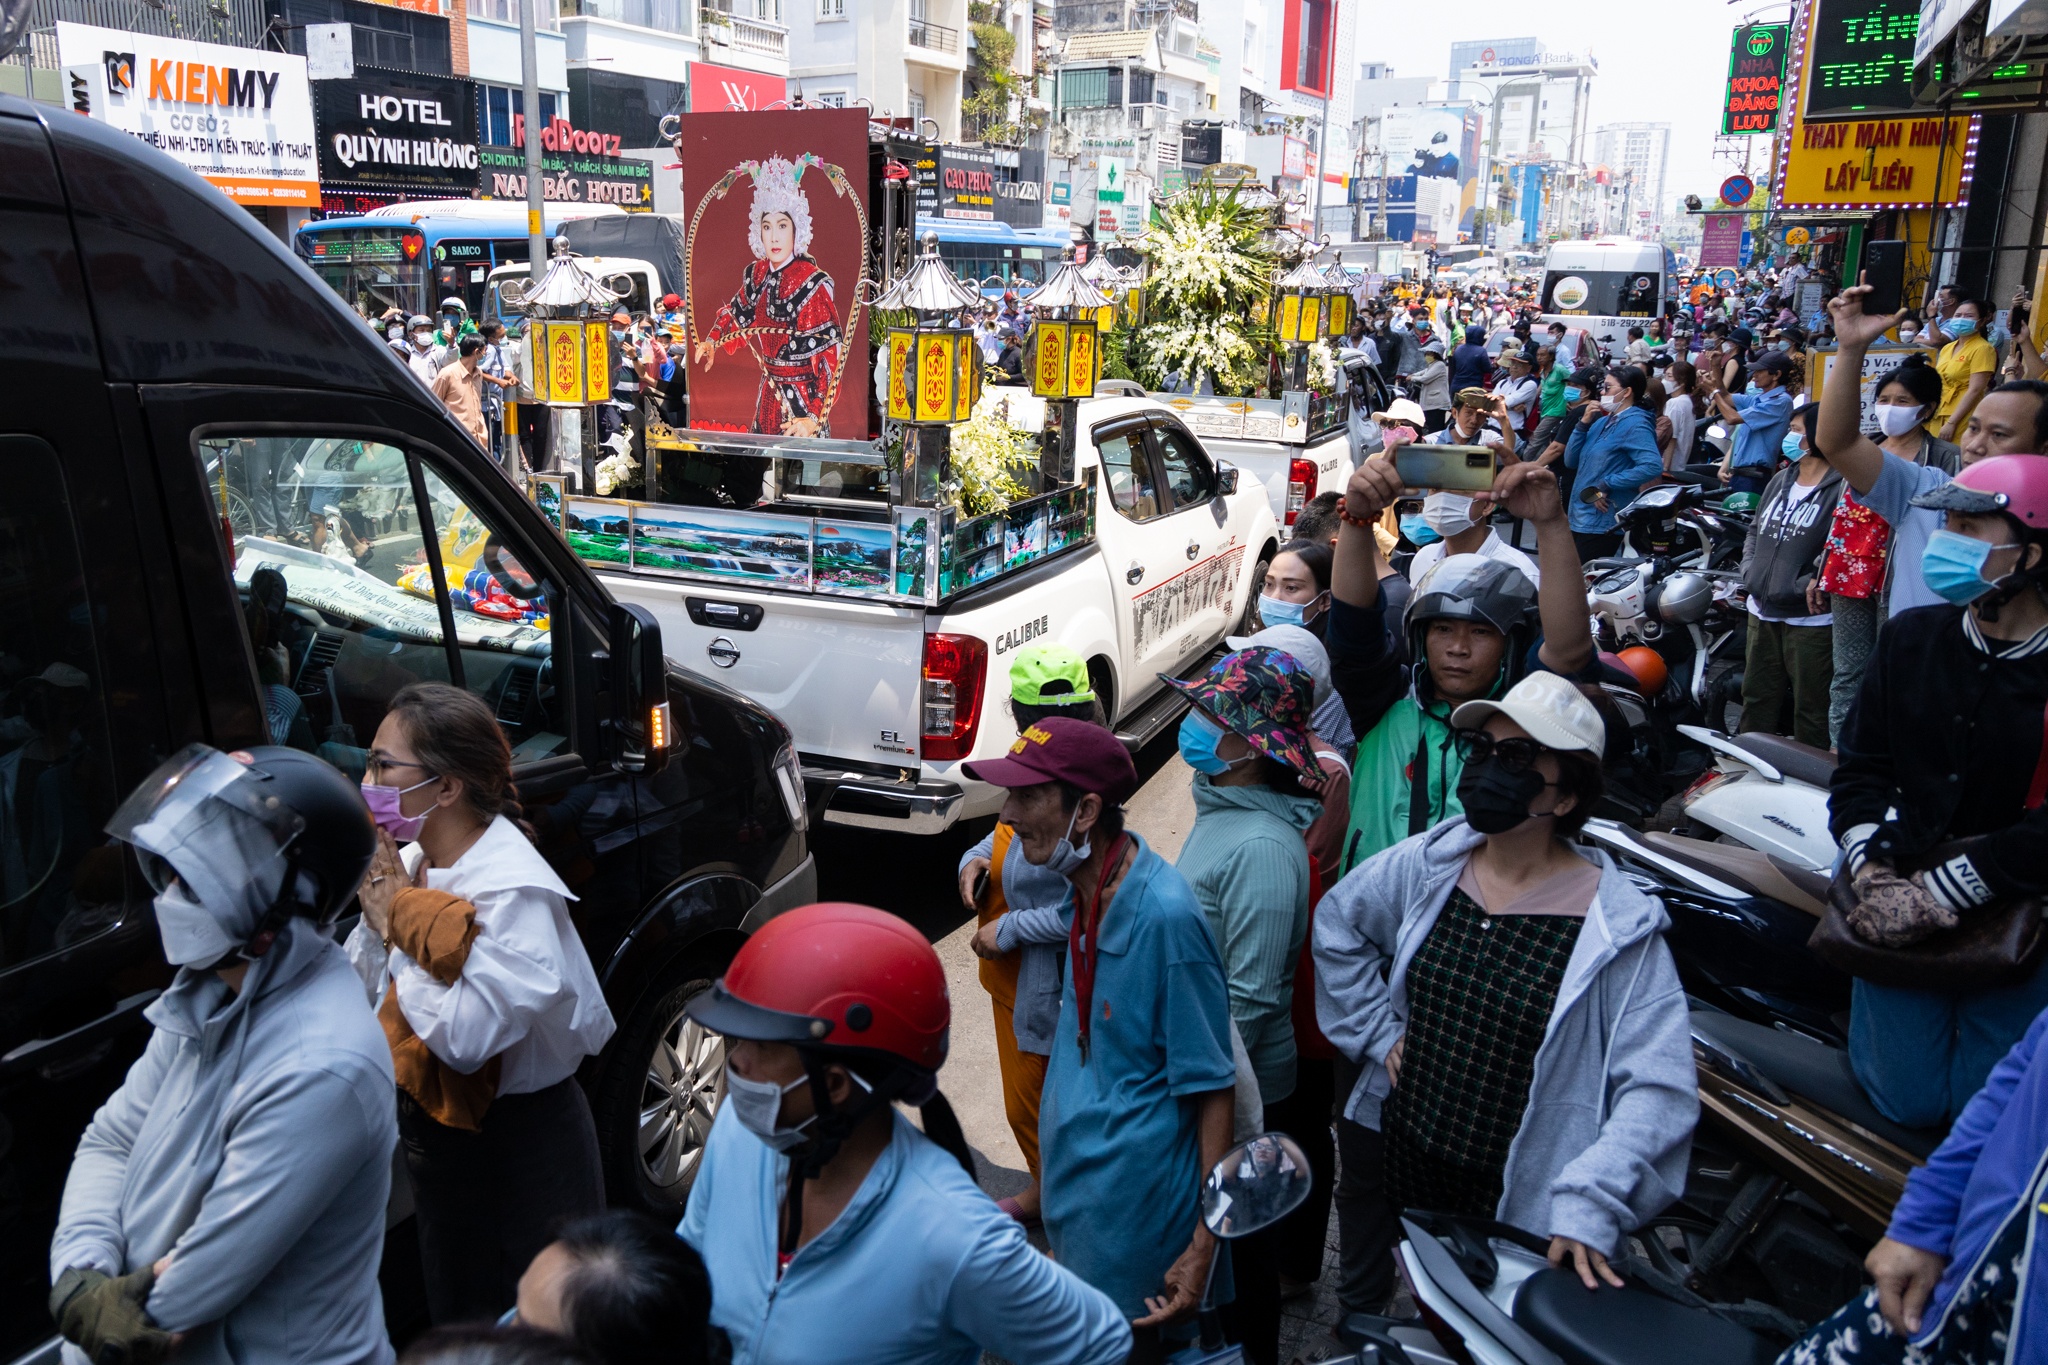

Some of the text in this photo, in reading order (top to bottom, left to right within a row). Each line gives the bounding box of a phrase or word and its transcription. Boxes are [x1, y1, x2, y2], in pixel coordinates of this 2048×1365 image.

[1740, 58, 1775, 73] NHA
[150, 59, 280, 109] KIENMY
[1731, 76, 1779, 92] KHOA
[360, 94, 451, 126] HOTEL
[1729, 93, 1778, 112] ĐĂNG
[222, 119, 230, 135] 2
[1733, 115, 1769, 130] LƯU
[514, 113, 622, 157] RdDoorz
[1803, 118, 1958, 150] THAY MÀN HÌNH
[217, 137, 239, 154] KIẾN
[241, 139, 266, 157] TRÚC
[272, 142, 284, 157] MỸ
[287, 143, 312, 161] THUẬT
[334, 127, 409, 168] QUỲNH
[574, 159, 600, 174] KHÁCH
[618, 164, 635, 177] NAM
[945, 168, 966, 189] CAO
[1824, 158, 1914, 192] LẤY LIỀN
[586, 180, 641, 205] HOTEL
[451, 246, 481, 256] SAMCO
[1729, 500, 1750, 509] Grab
[995, 614, 1048, 655] CALIBRE
[881, 729, 905, 743] EL
